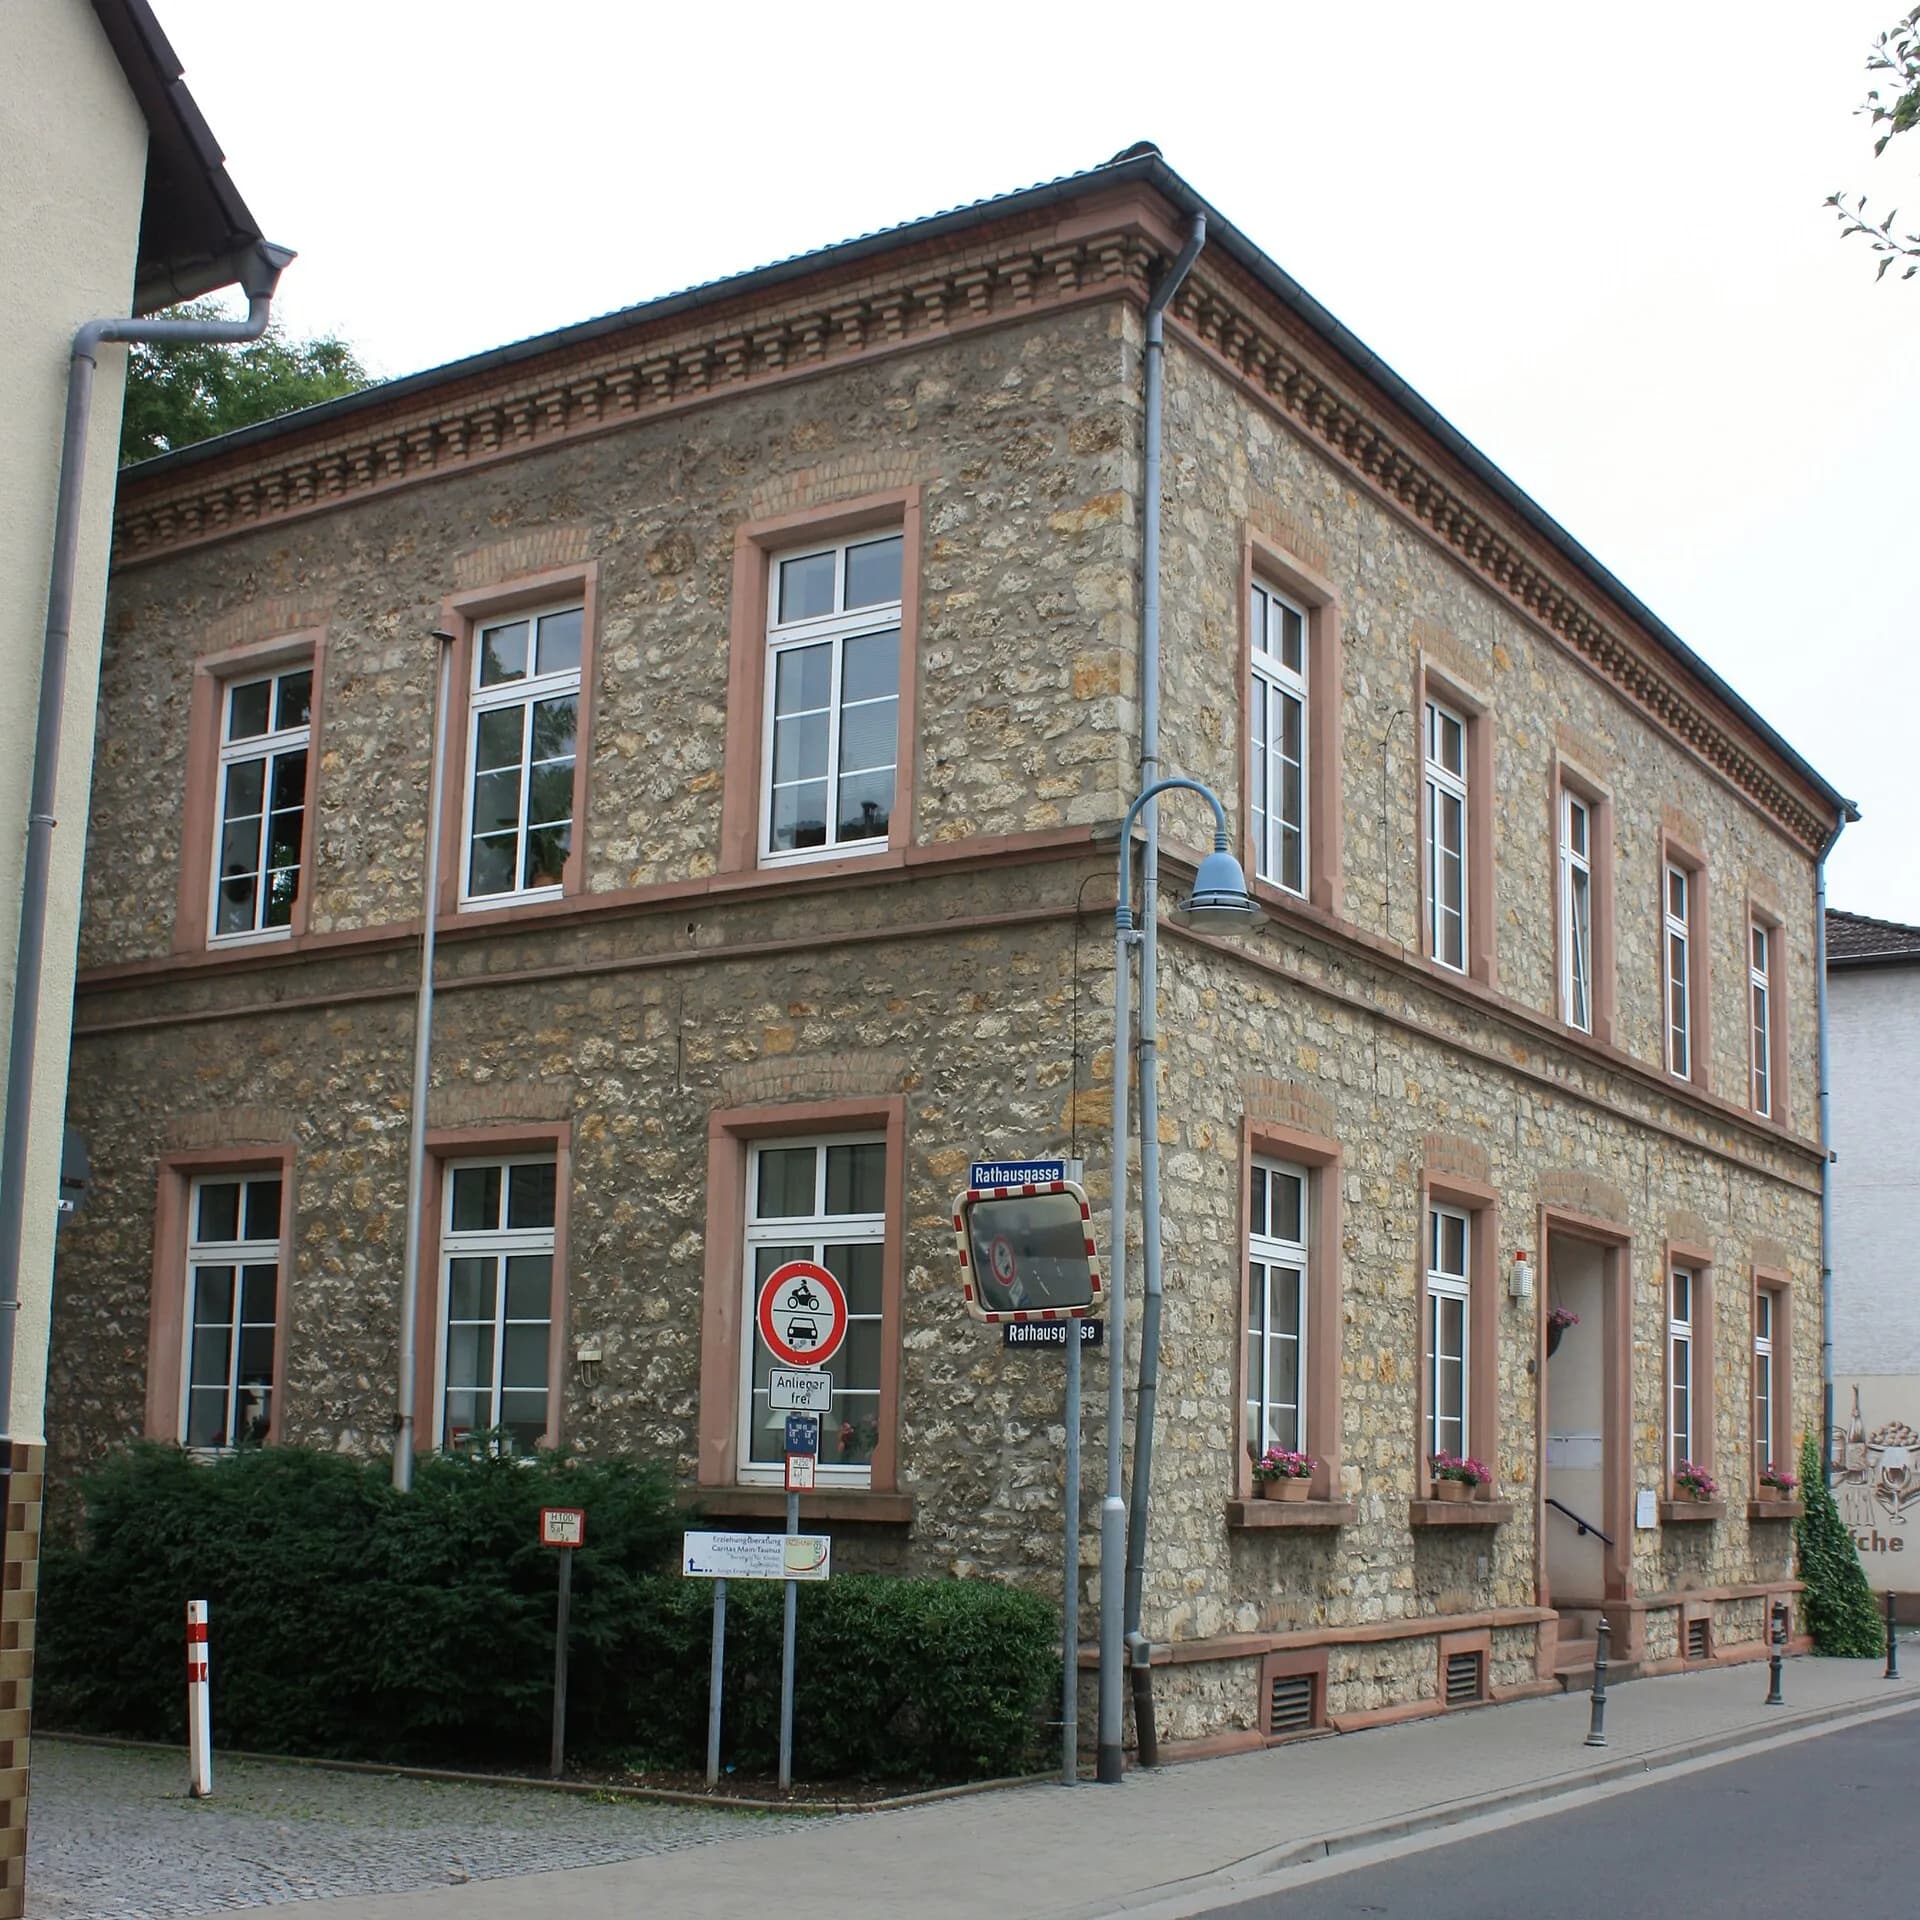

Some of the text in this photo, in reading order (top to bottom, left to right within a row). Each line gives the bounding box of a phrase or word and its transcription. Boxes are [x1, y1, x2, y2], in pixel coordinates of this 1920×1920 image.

[975, 1166, 1060, 1184] Rathausgasse
[1009, 1324, 1095, 1343] Rathausgse
[776, 1376, 825, 1393] Anlieger
[791, 1392, 811, 1406] frei
[711, 1544, 736, 1553] Caritas
